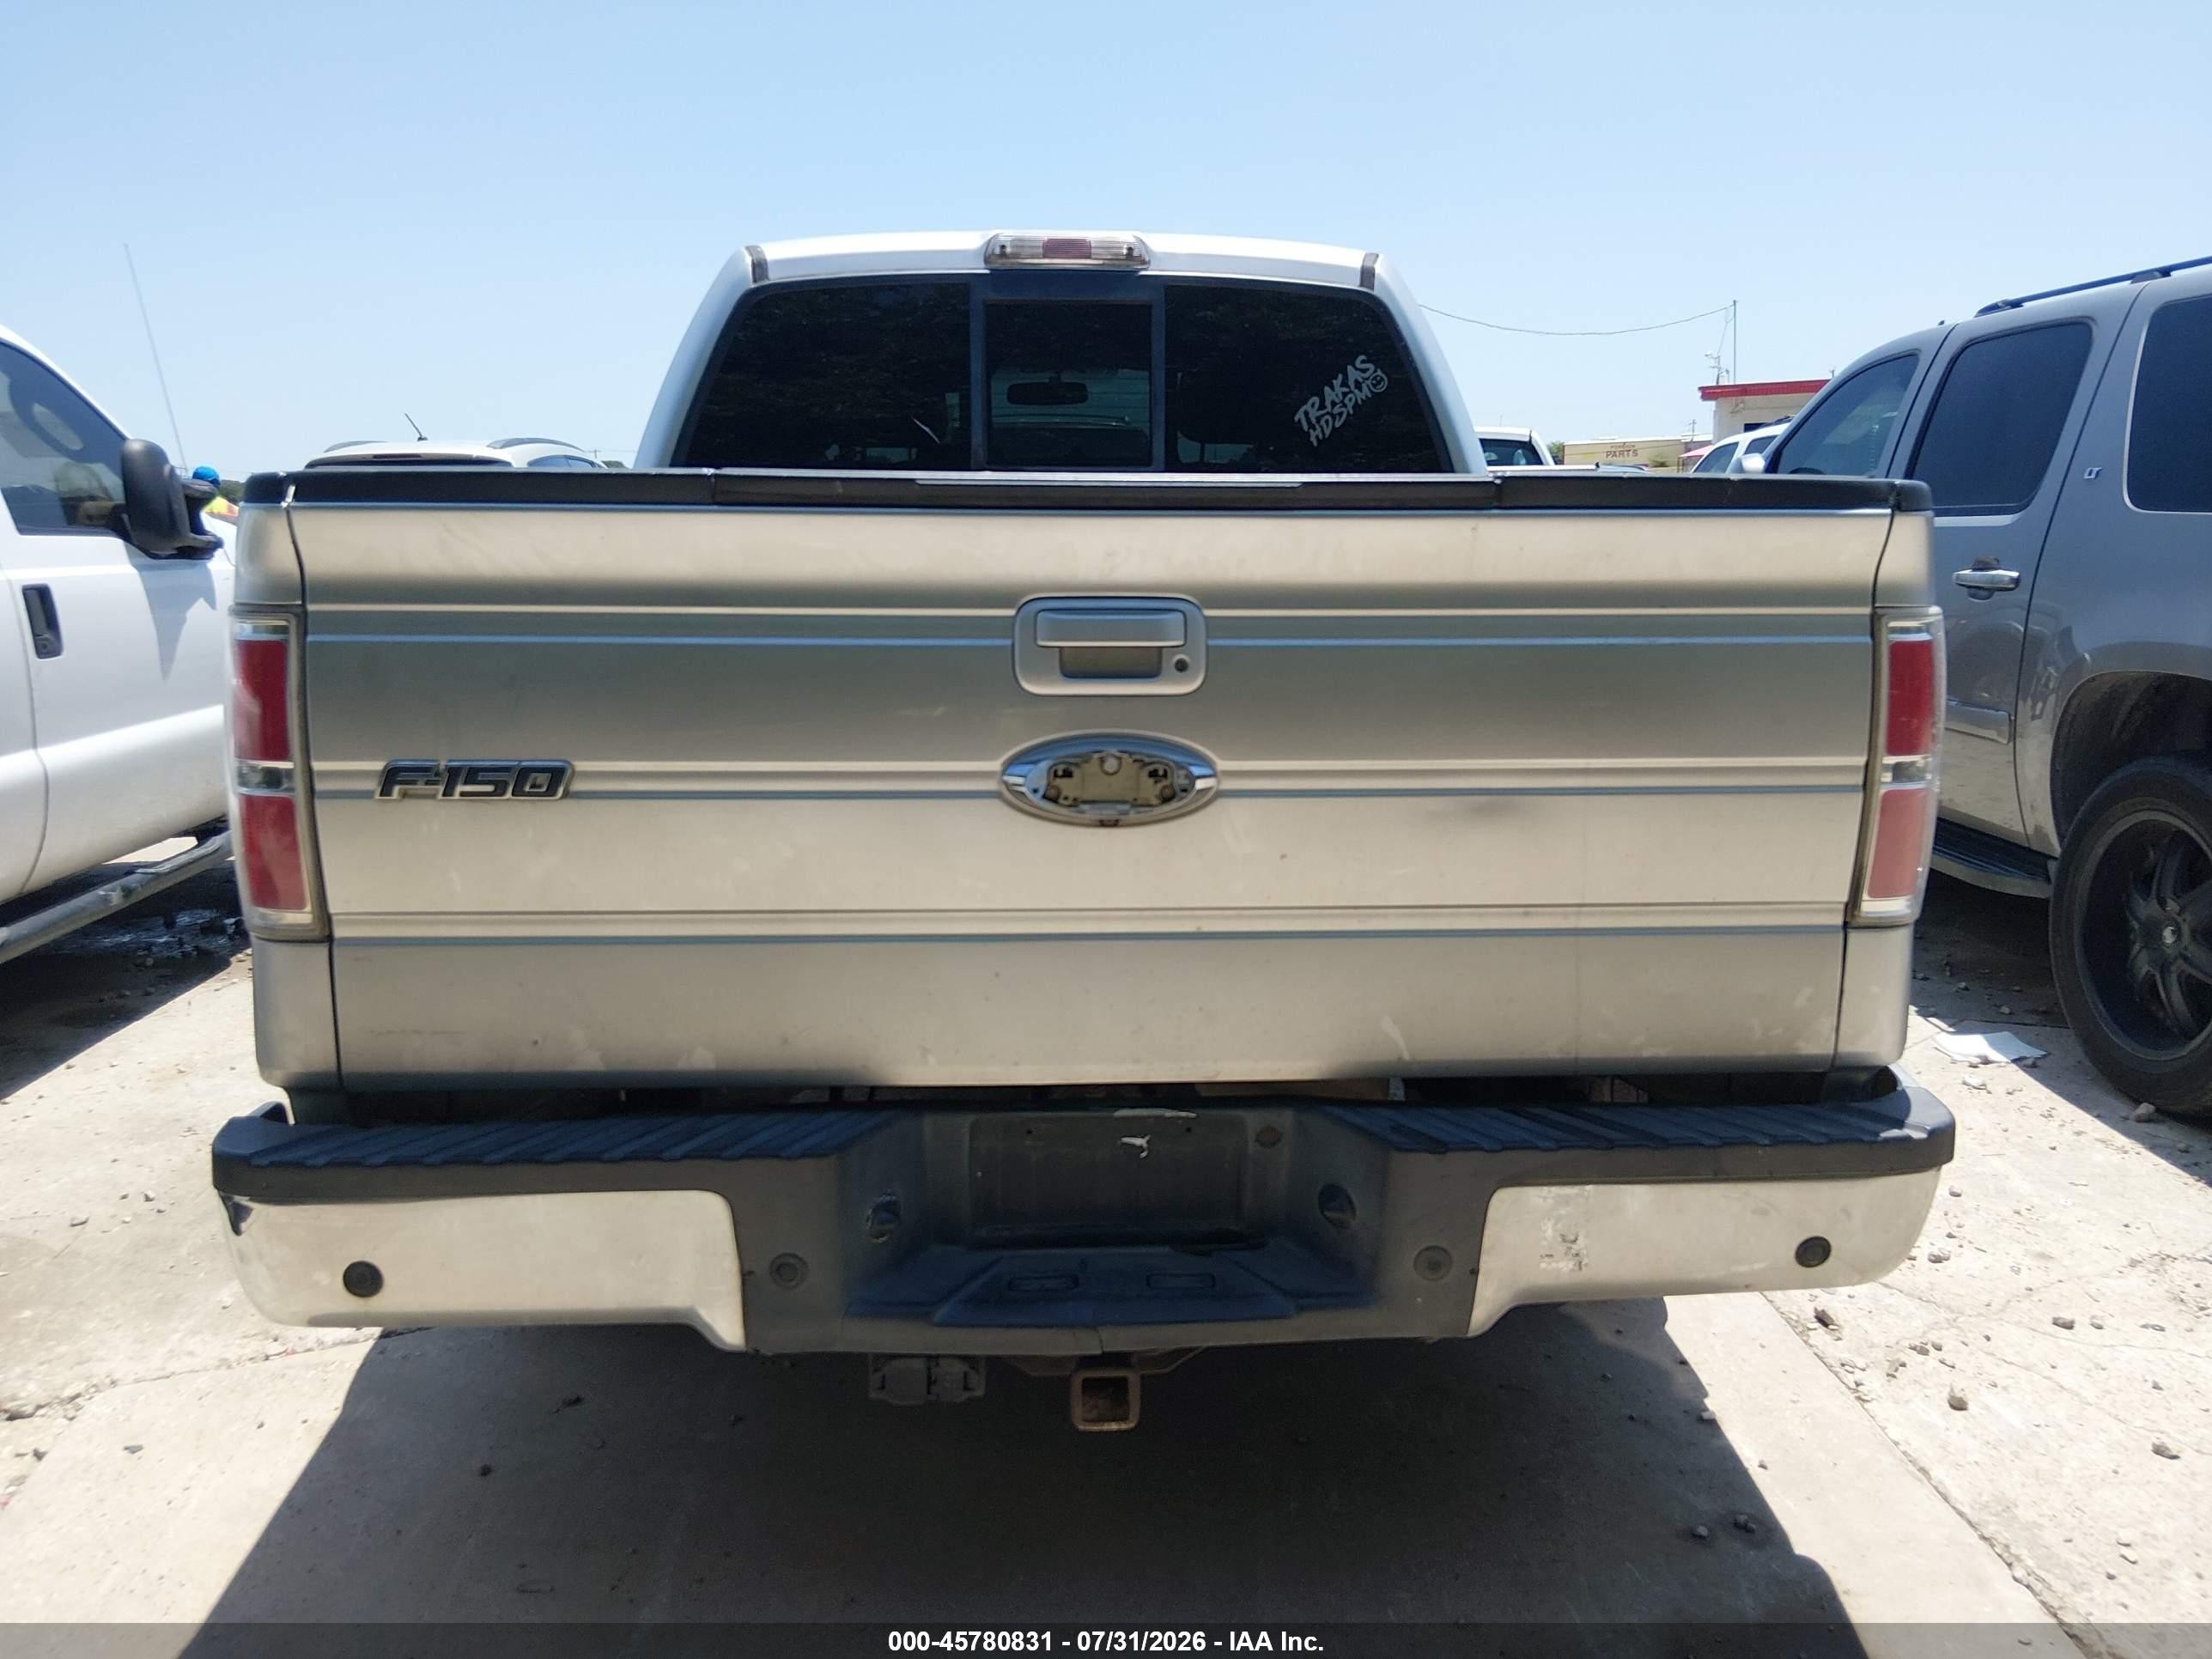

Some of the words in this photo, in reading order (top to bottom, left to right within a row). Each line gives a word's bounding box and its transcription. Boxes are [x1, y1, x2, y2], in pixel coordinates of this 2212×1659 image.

[1294, 355, 1374, 432] TRAKAS
[1606, 449, 1639, 459] PARTS
[2084, 467, 2103, 479] LT
[374, 759, 574, 800] F-150
